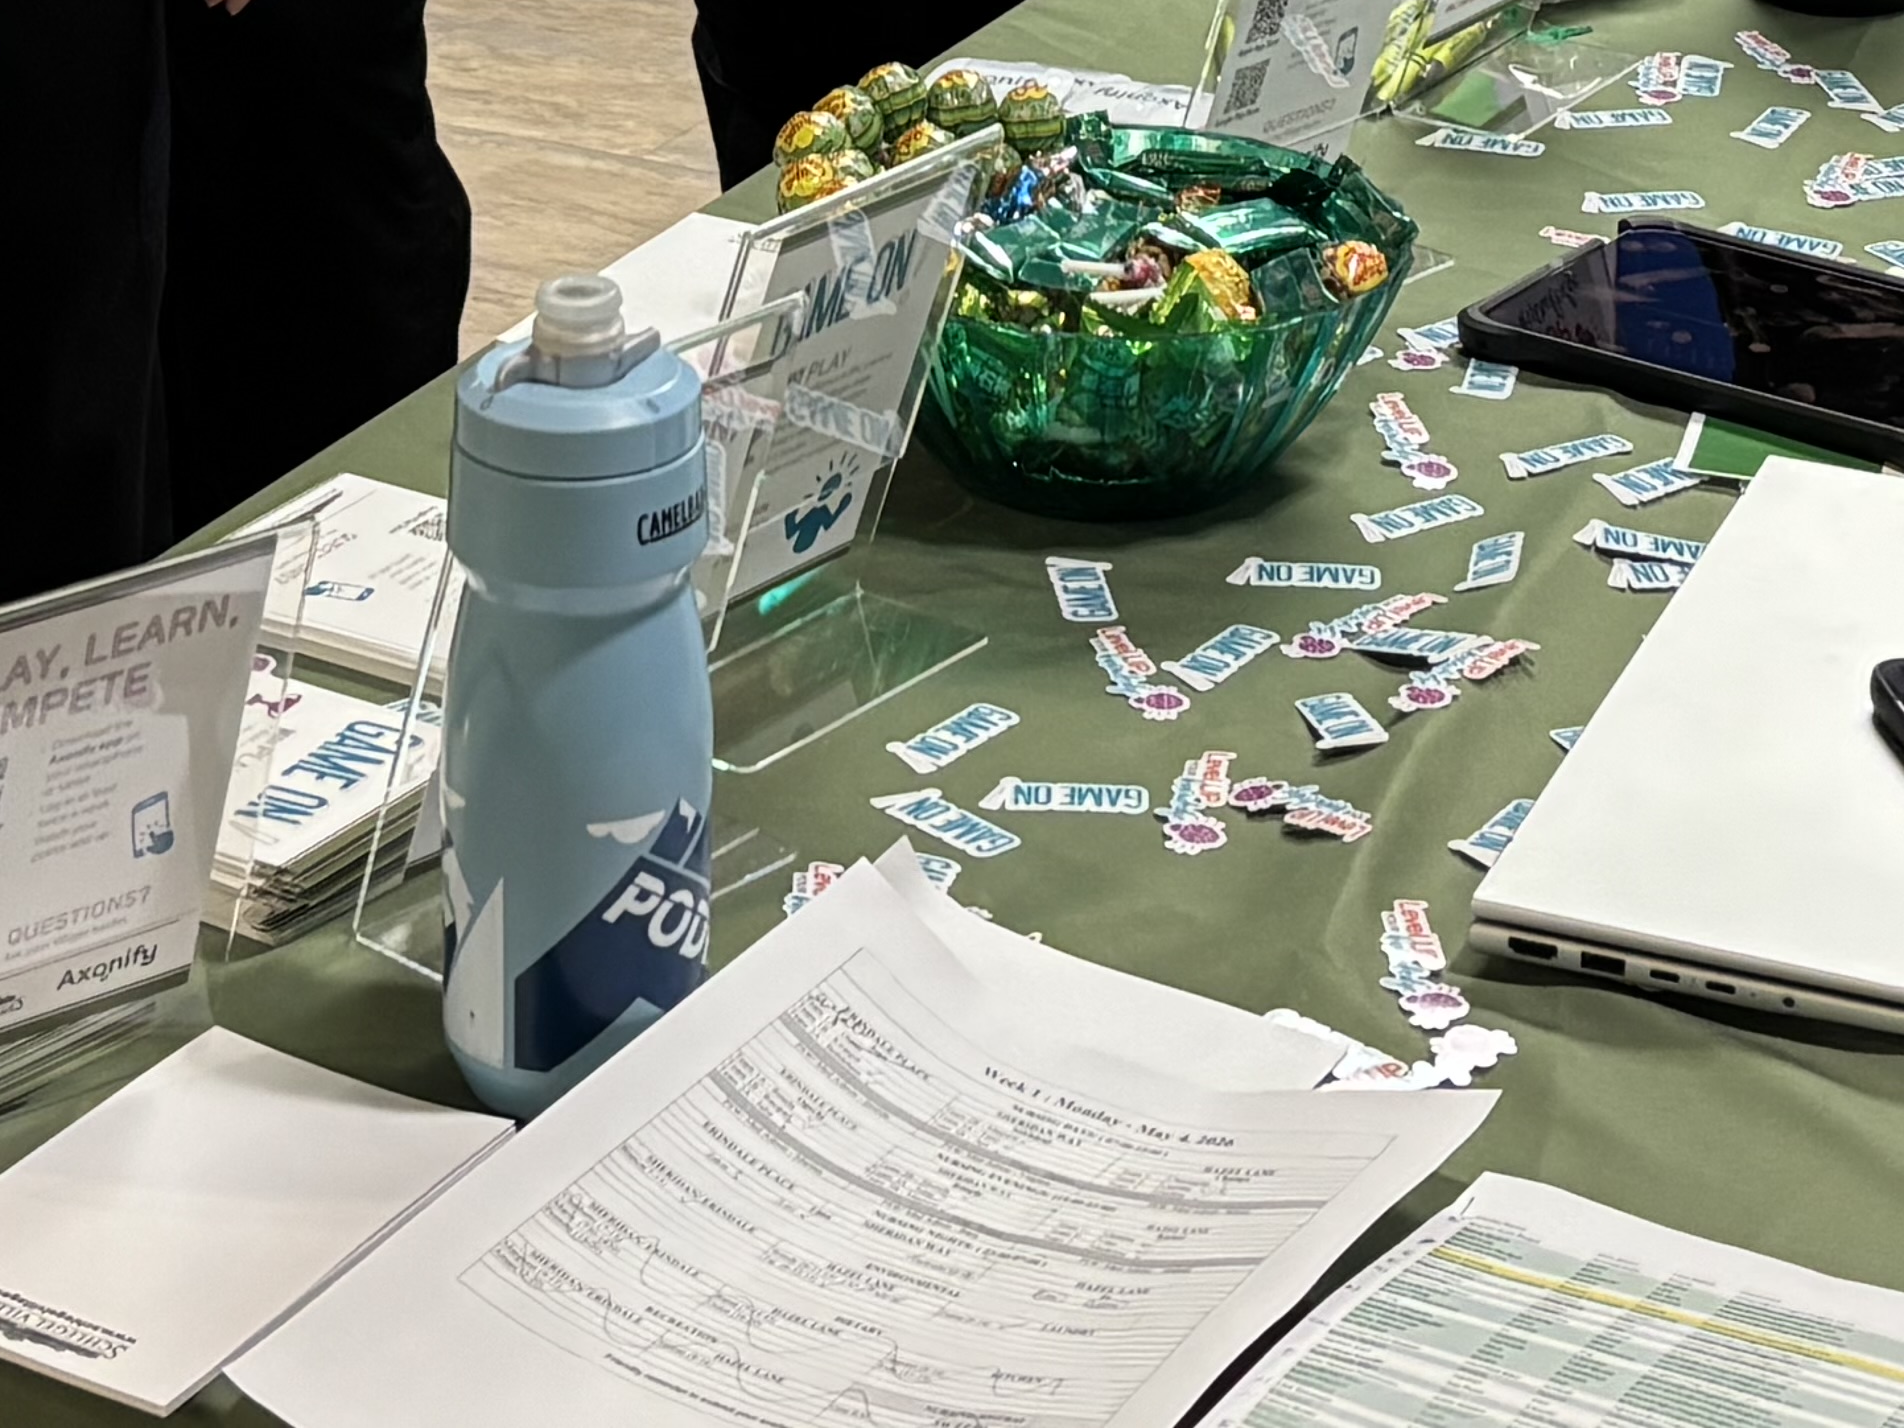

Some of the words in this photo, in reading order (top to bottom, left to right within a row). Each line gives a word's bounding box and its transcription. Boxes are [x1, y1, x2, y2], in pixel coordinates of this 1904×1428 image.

[1603, 526, 1639, 547] ON
[1647, 532, 1706, 561] AME
[1258, 564, 1294, 581] ON
[1302, 565, 1375, 586] GAME
[1631, 562, 1670, 584] ON
[957, 706, 1013, 744] GAME
[898, 797, 951, 821] ON
[1013, 783, 1053, 806] ON
[1059, 785, 1143, 808] GAME
[937, 808, 1015, 852] GAME
[7, 887, 152, 946] QUESTIONS?
[601, 871, 711, 965] POD
[56, 944, 157, 992] Axonify
[984, 1066, 1026, 1093] Week
[1054, 1096, 1123, 1128] Monday
[1136, 1123, 1171, 1142] May
[35, 1312, 129, 1360] SCHLEGEL
